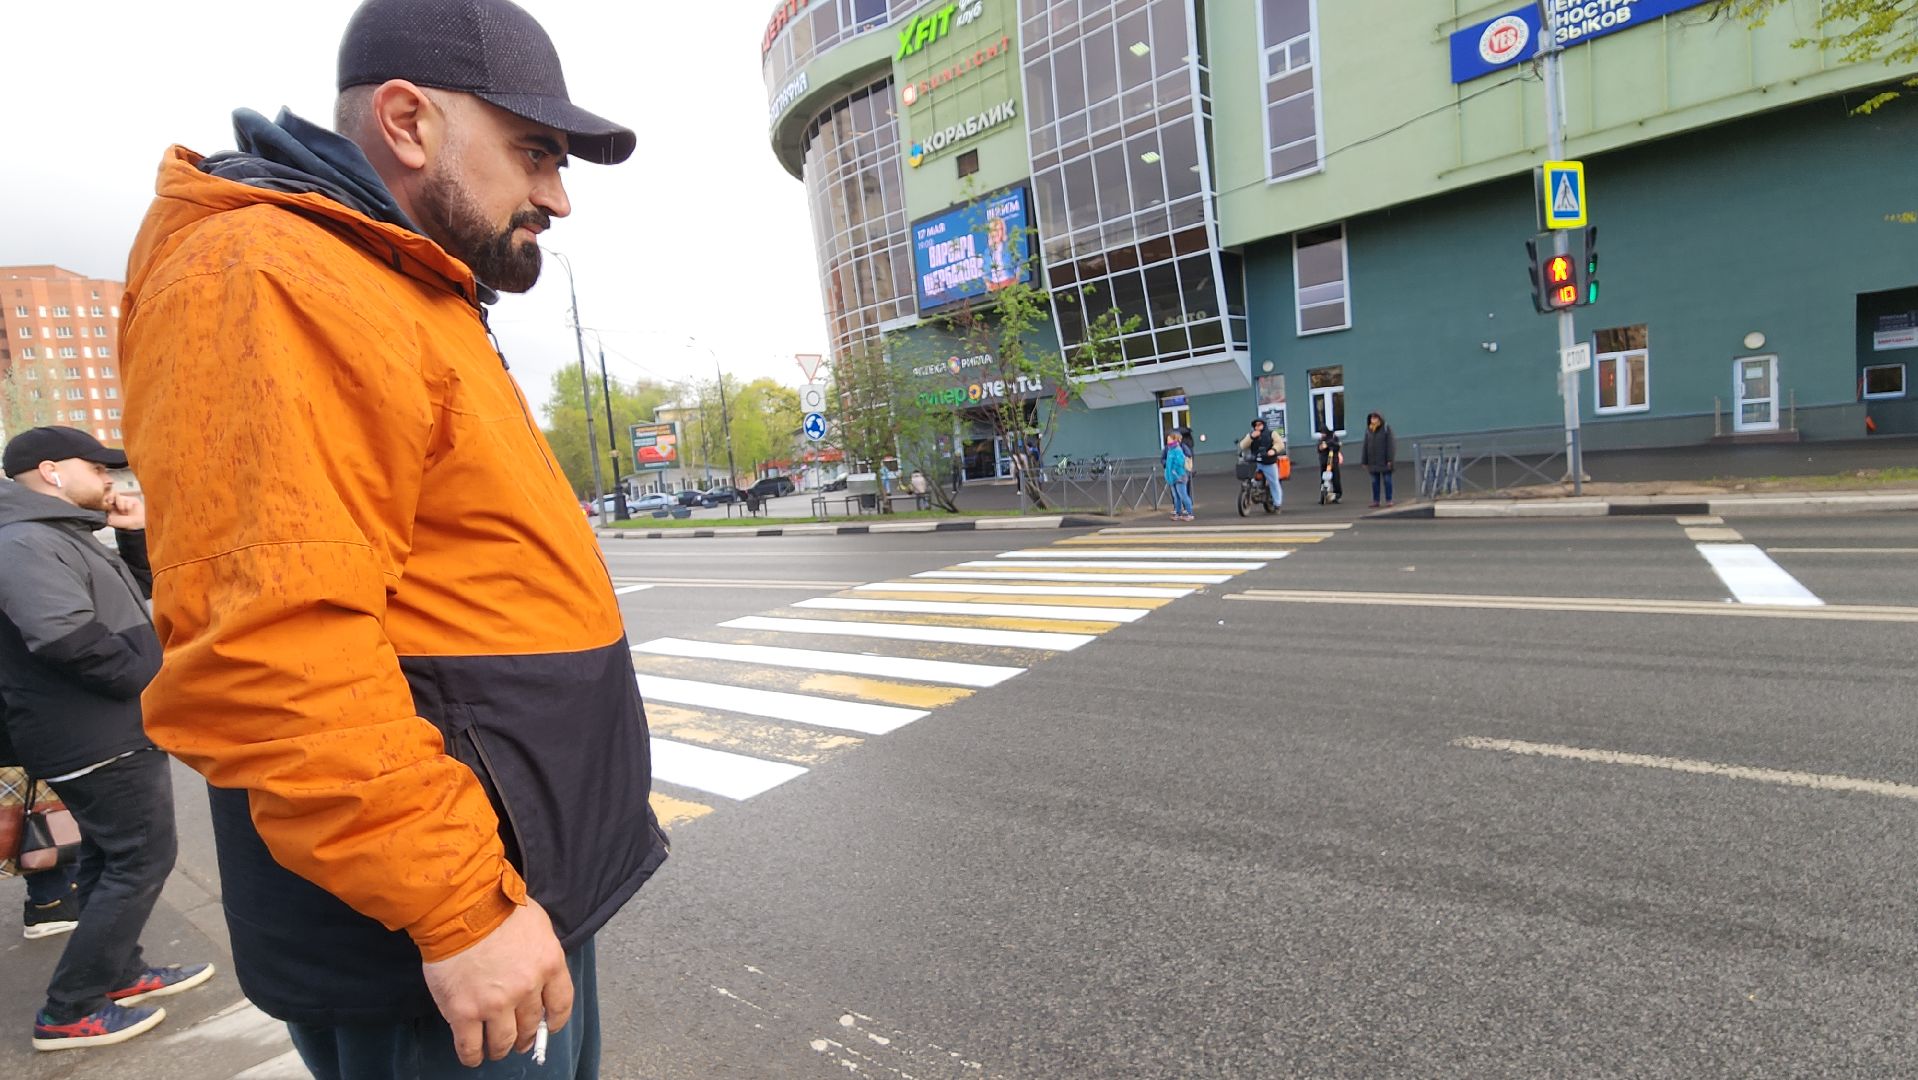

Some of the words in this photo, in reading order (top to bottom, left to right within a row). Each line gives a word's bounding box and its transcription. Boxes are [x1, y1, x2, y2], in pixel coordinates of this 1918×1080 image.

[956, 0, 983, 27] клуб
[1556, 6, 1631, 43] ЗЫКОВ
[896, 4, 955, 62] XFIT
[1491, 28, 1517, 52] YES
[922, 98, 1016, 154] КОРАБЛИК
[926, 222, 946, 237] МАЯ
[1560, 285, 1576, 303] 10
